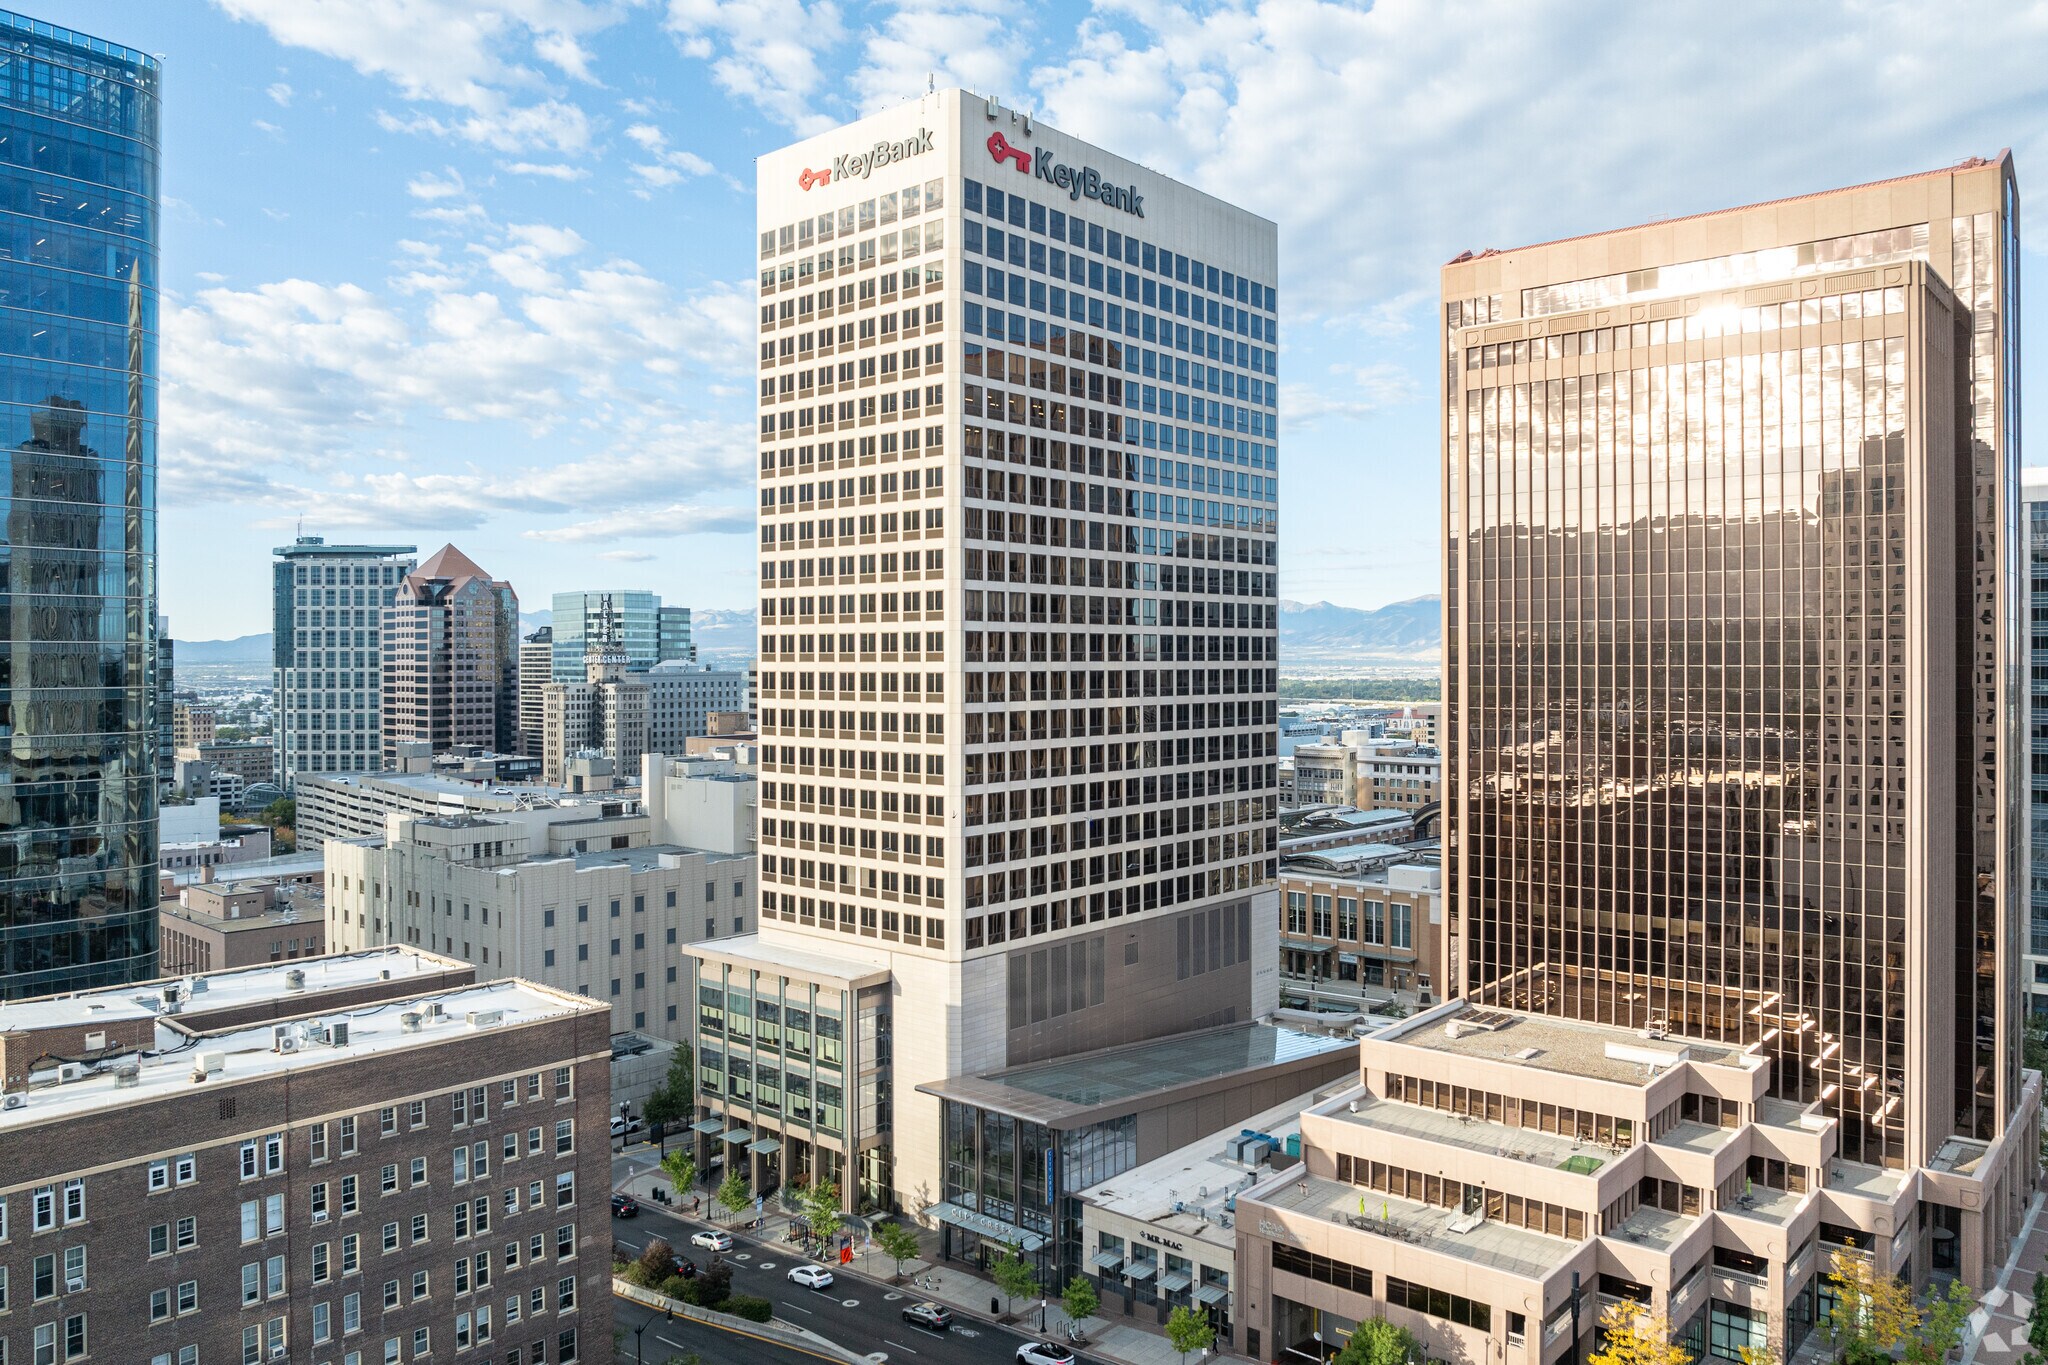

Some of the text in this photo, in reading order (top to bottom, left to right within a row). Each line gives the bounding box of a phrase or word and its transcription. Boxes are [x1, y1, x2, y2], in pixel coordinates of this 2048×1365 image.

[833, 127, 934, 181] KeyBank
[1035, 147, 1145, 218] KeyBank
[602, 655, 631, 664] CENTER
[951, 1208, 1014, 1236] CITY CREEK
[1163, 1238, 1183, 1251] MAC
